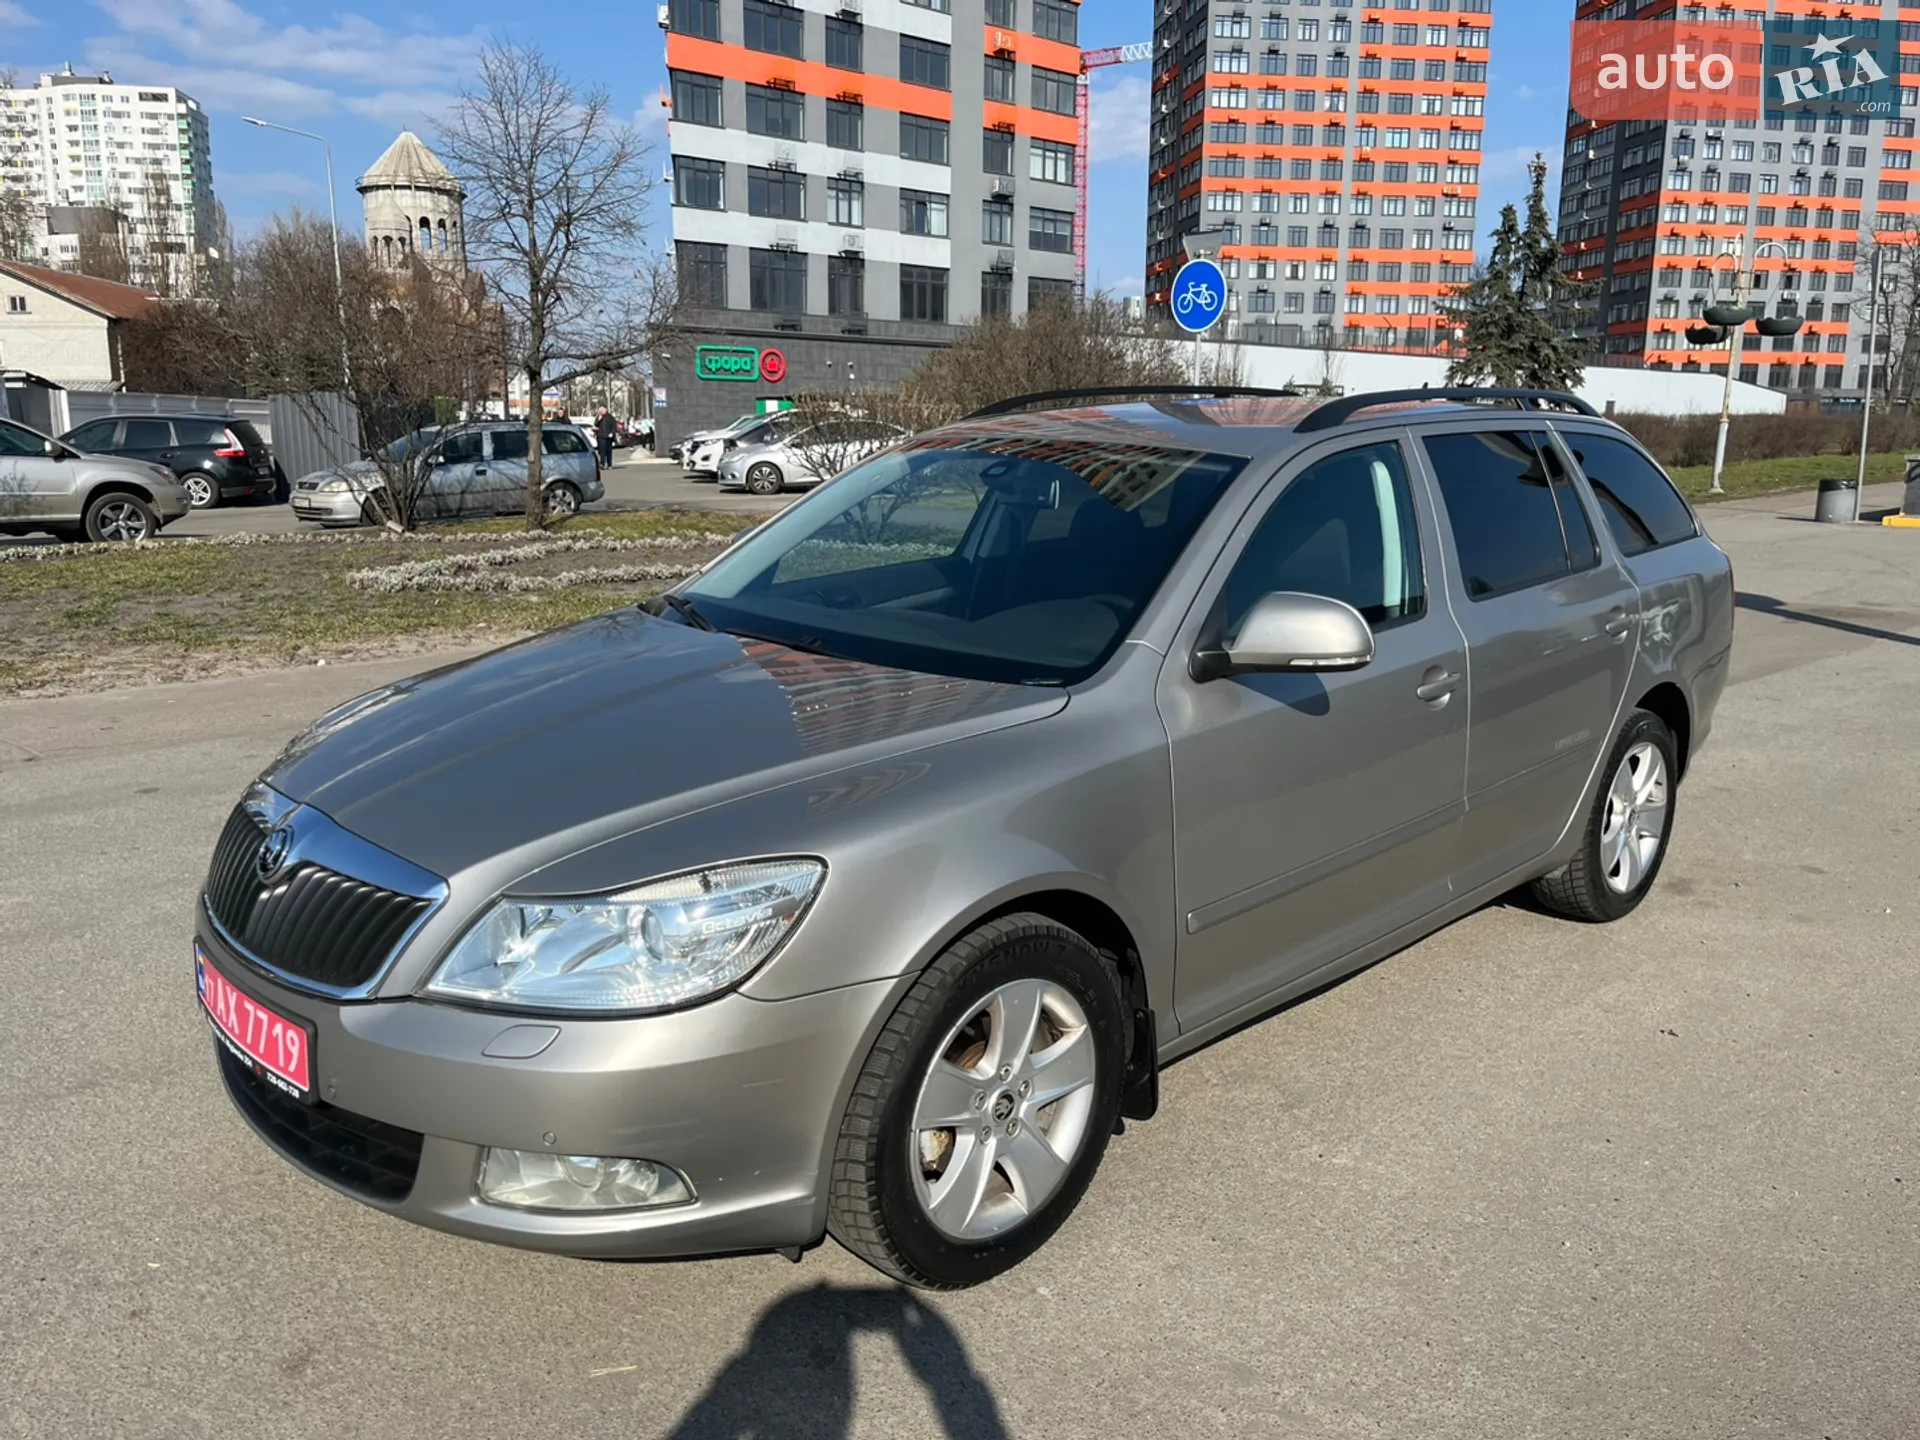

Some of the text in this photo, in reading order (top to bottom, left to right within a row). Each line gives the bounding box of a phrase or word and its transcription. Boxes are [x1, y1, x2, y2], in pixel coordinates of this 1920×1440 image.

[705, 355, 751, 373] фора
[702, 907, 773, 934] Octavia
[243, 999, 300, 1074] 7719
